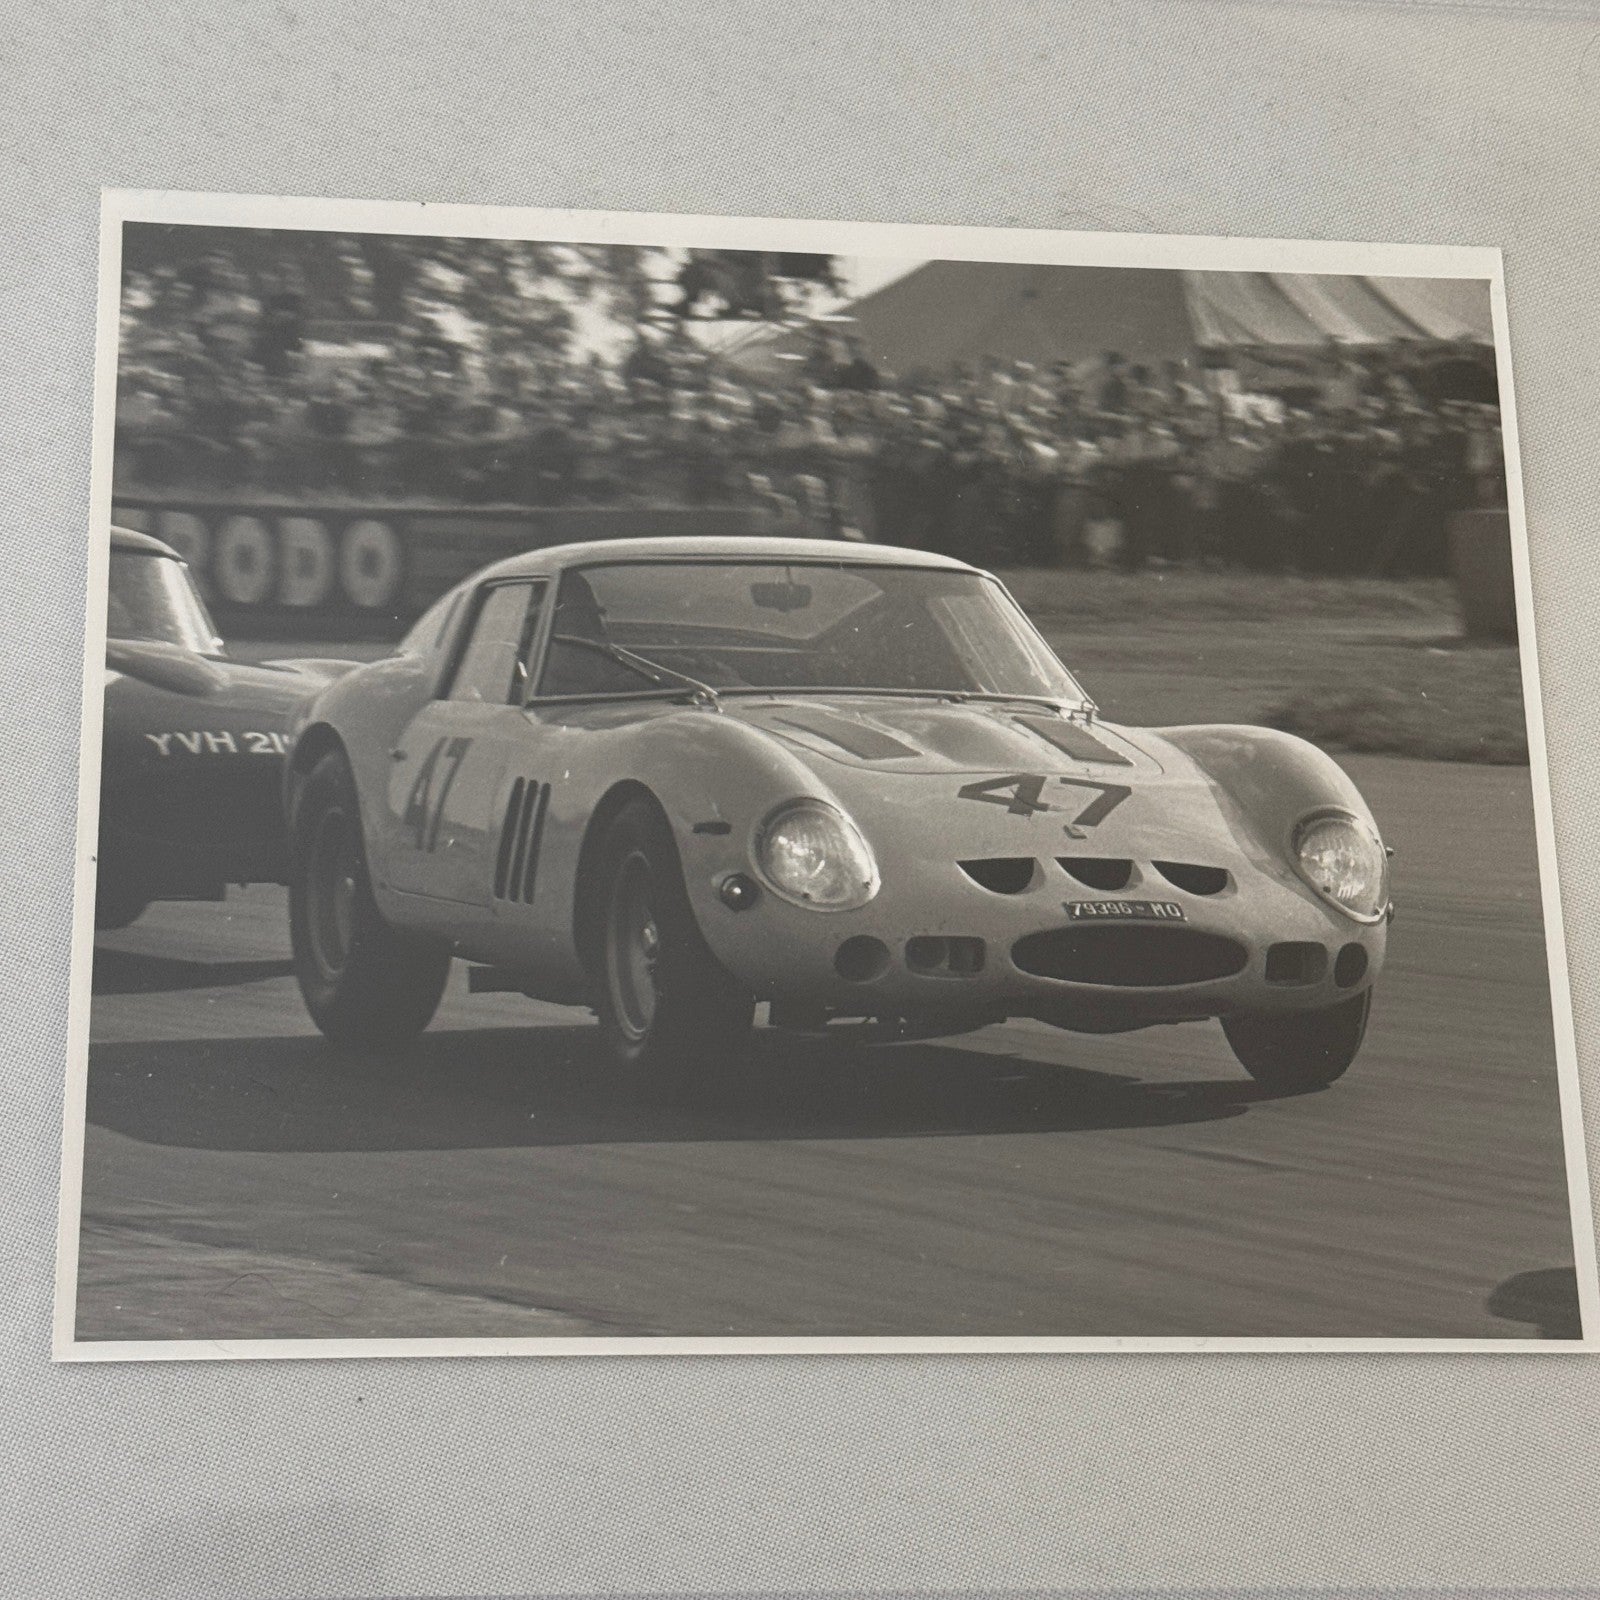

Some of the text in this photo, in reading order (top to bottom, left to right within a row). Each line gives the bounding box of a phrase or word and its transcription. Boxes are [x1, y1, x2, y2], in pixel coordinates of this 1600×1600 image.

[145, 731, 292, 755] YVH 21
[957, 773, 1132, 827] 47
